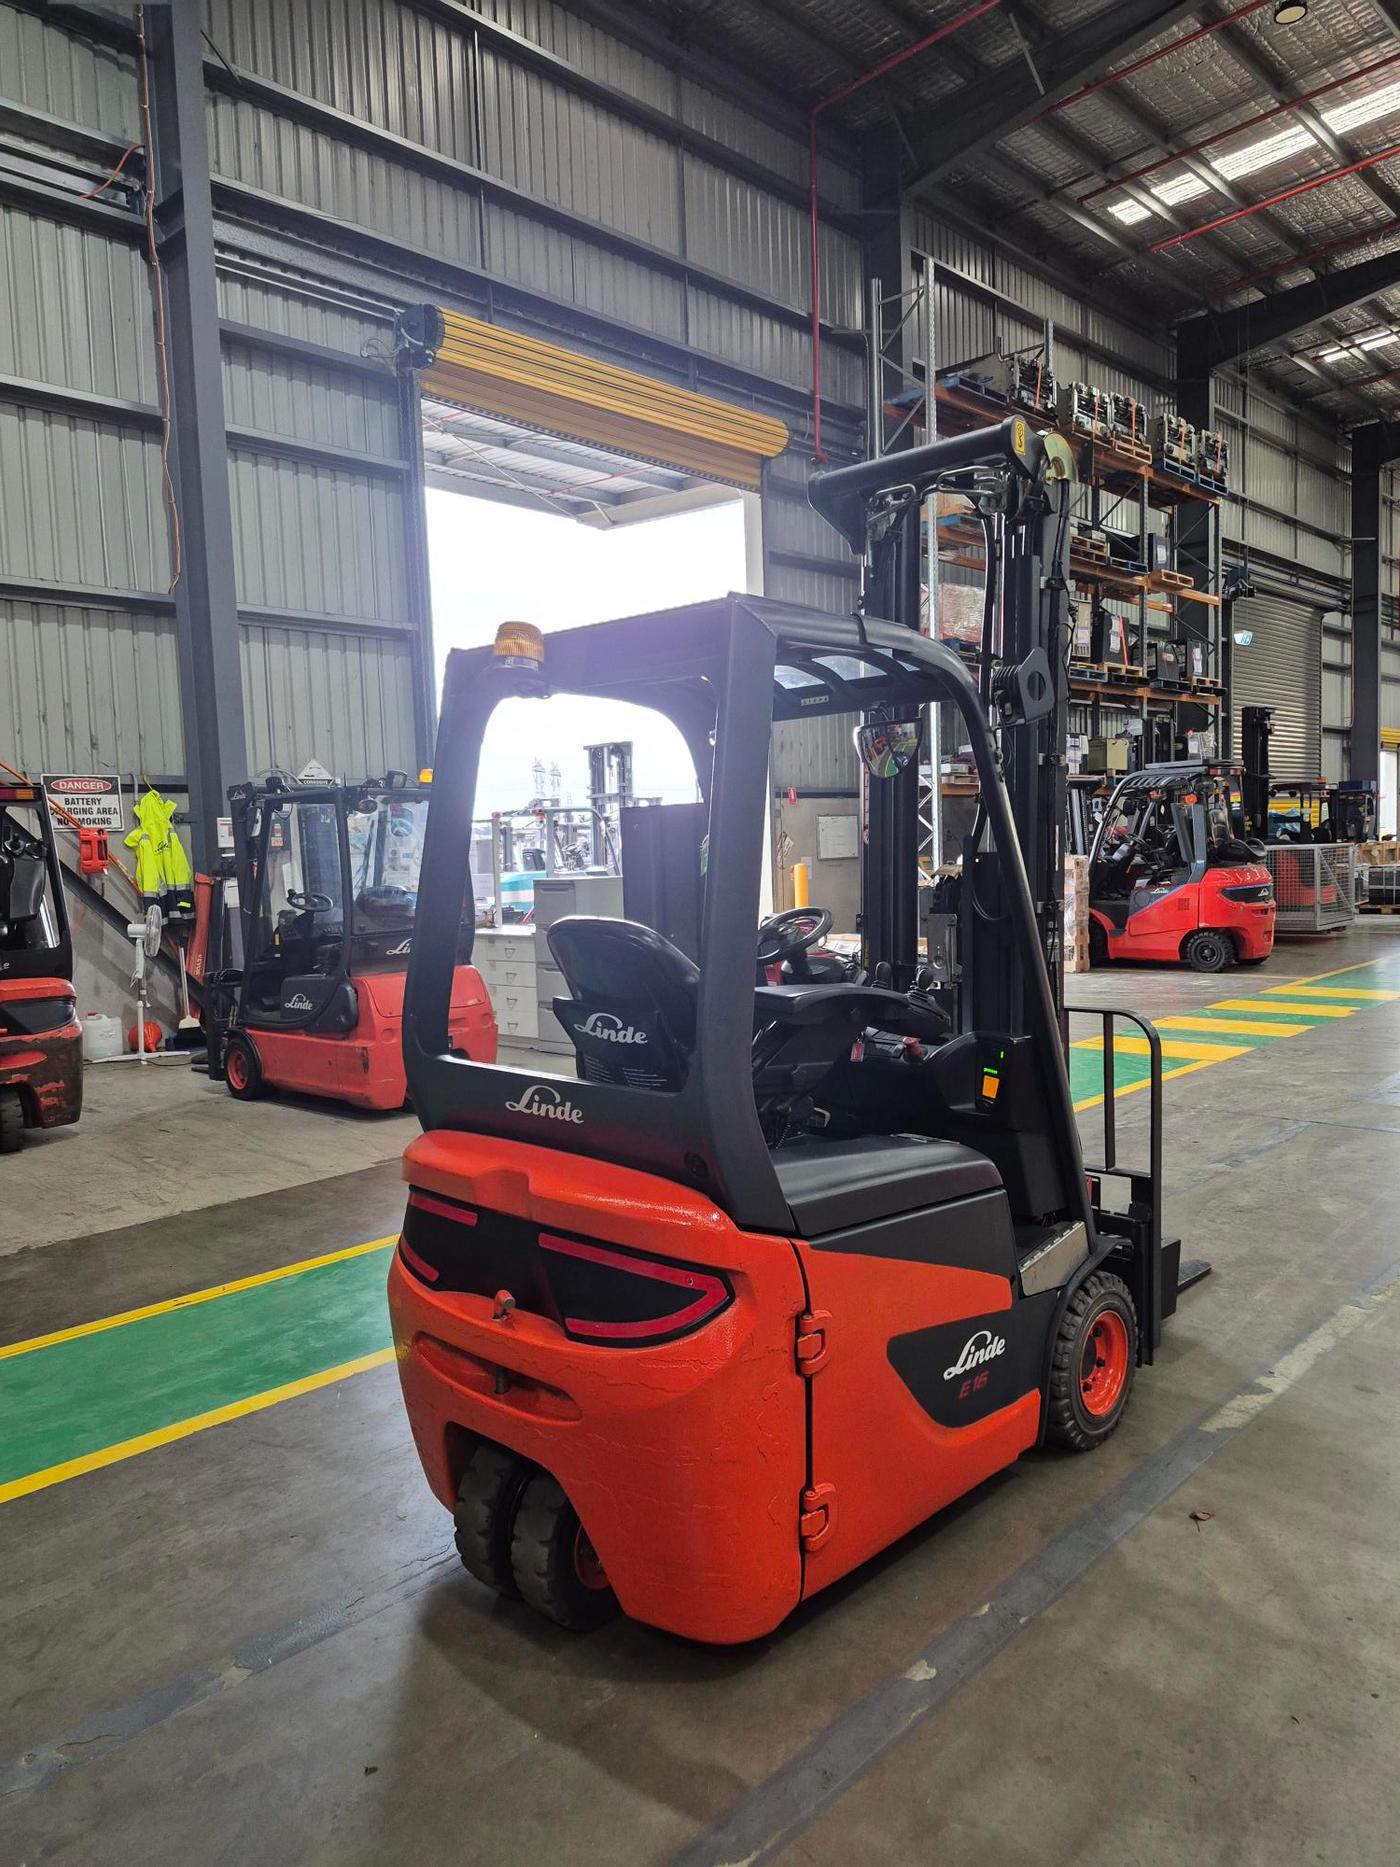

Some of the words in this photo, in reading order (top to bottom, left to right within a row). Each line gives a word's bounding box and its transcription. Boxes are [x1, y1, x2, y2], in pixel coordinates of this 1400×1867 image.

[60, 781, 104, 790] DANGER
[64, 797, 102, 806] BATTERY
[96, 807, 119, 816] AREA
[57, 817, 70, 826] NO
[284, 993, 313, 1011] Linde
[573, 1012, 649, 1045] Linde
[504, 1084, 585, 1124] Linde
[943, 1330, 1006, 1381] Linde
